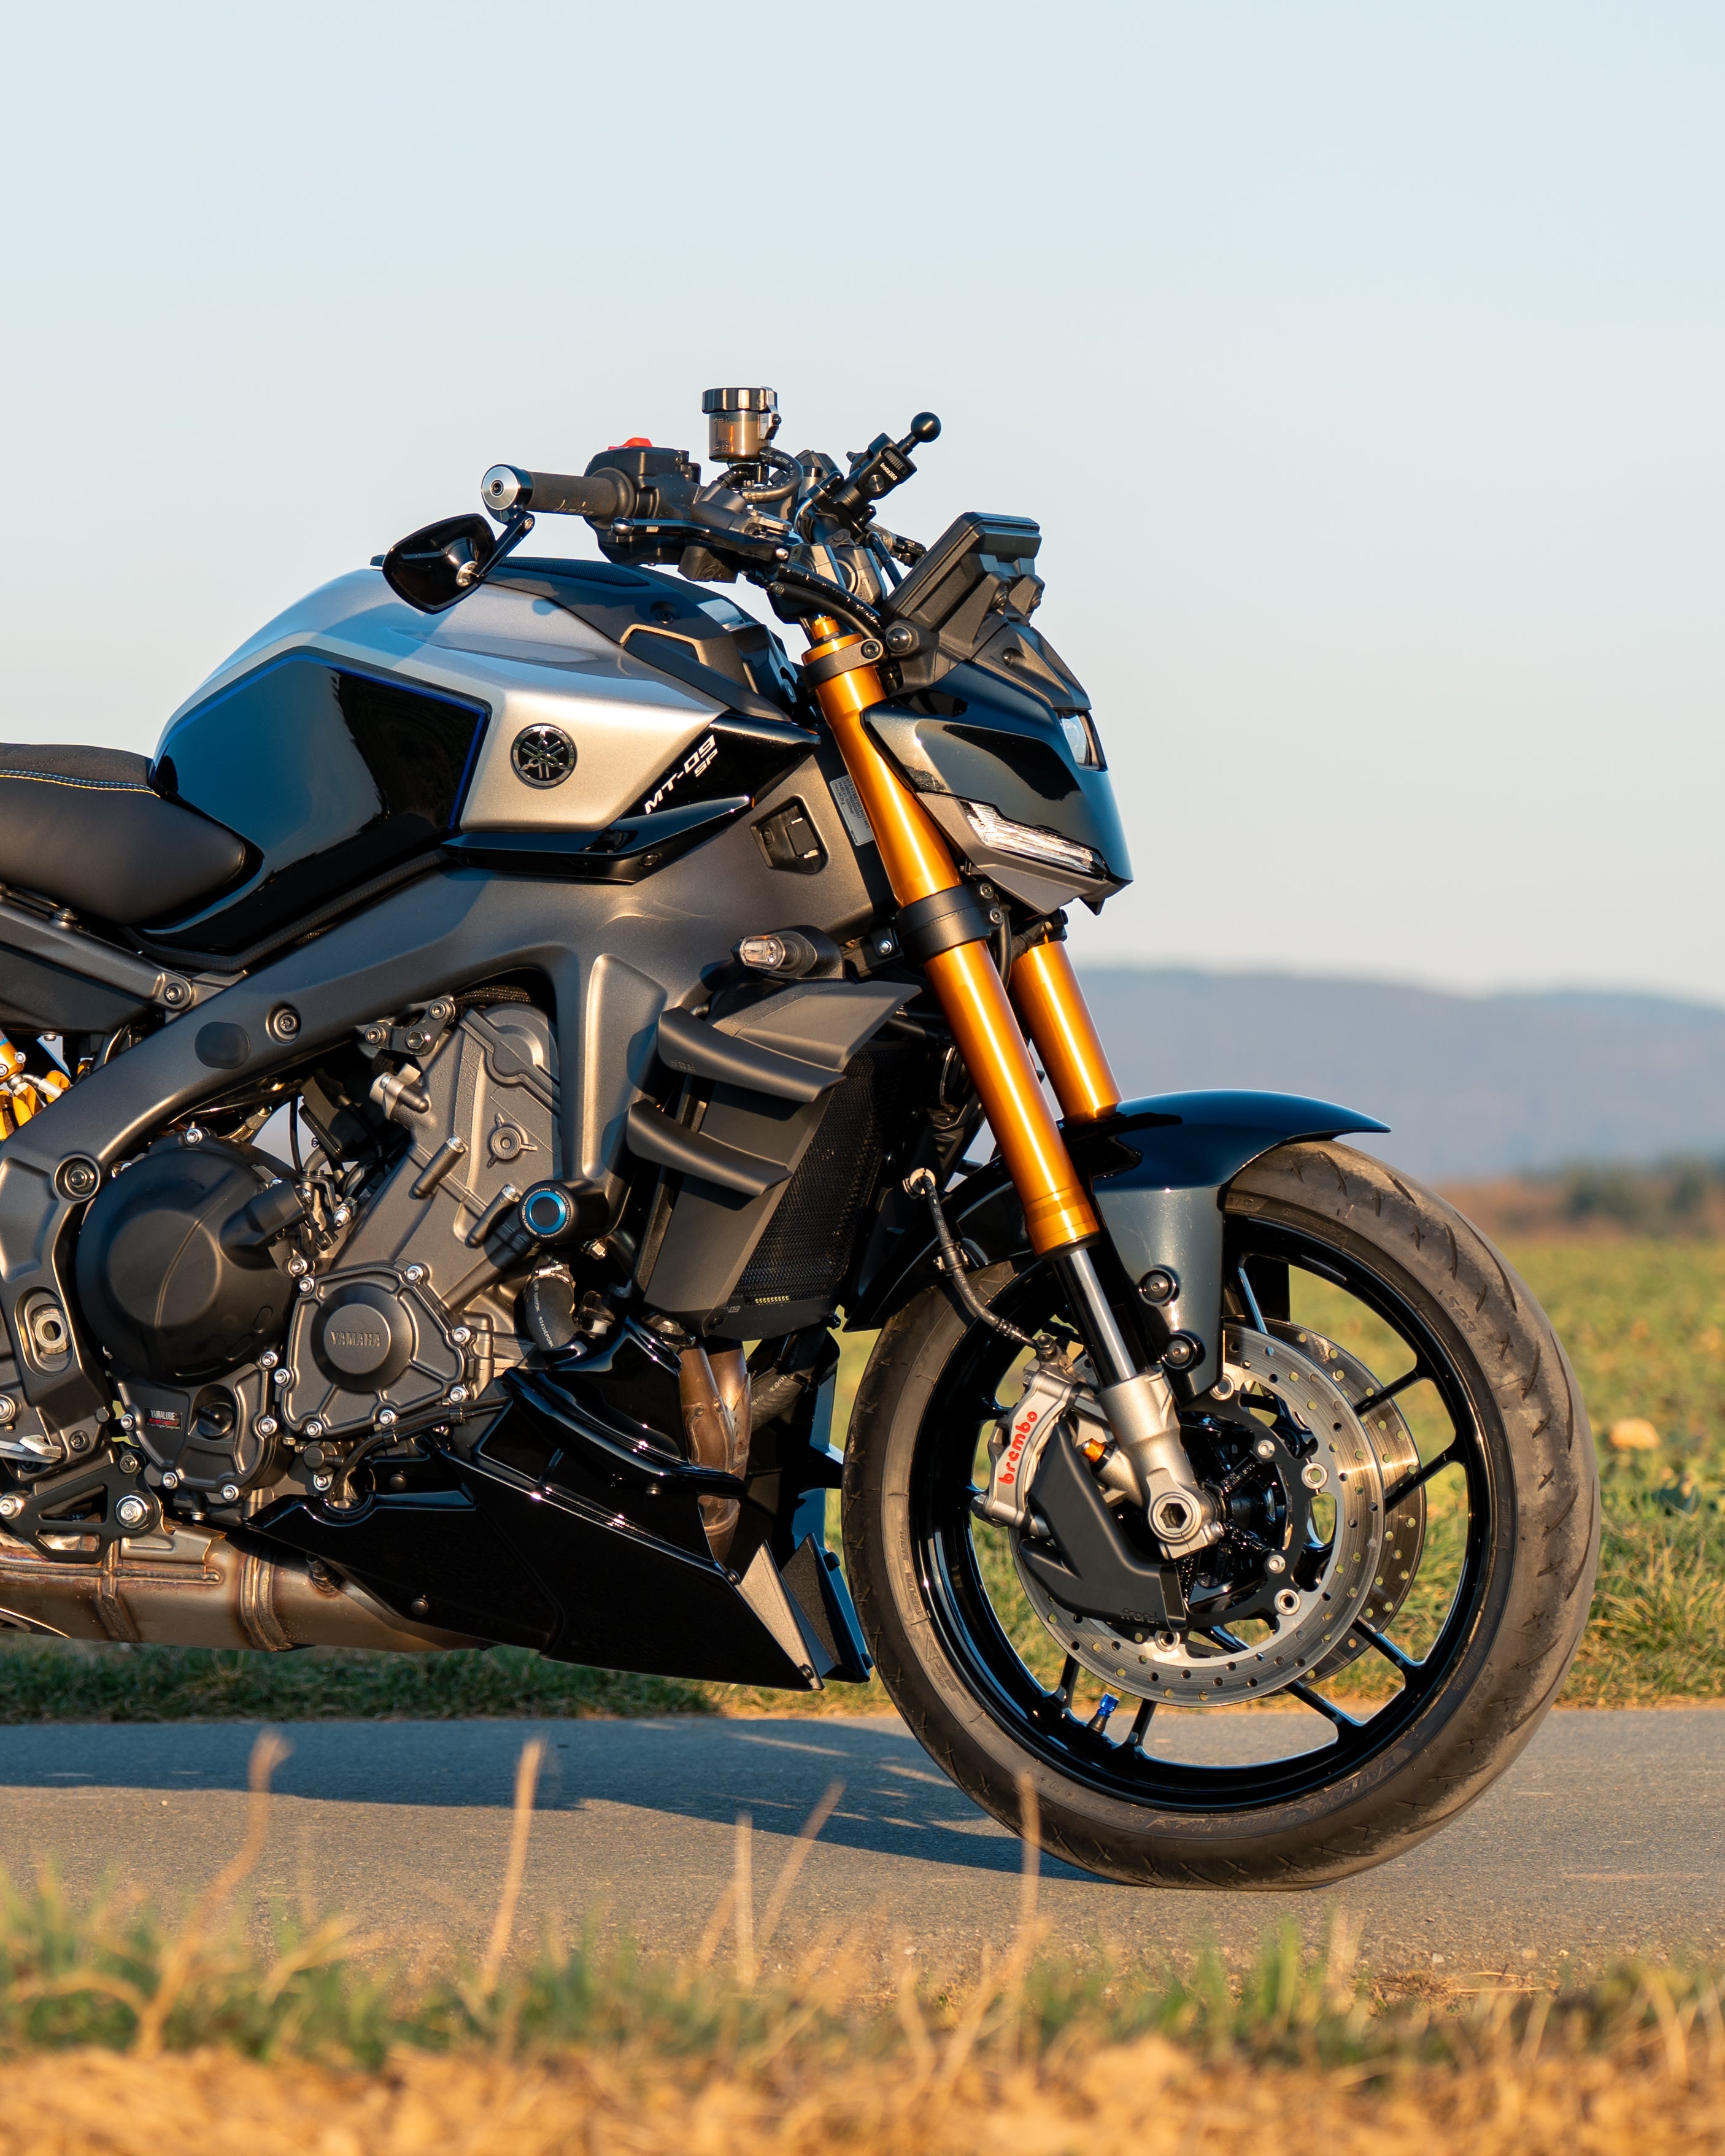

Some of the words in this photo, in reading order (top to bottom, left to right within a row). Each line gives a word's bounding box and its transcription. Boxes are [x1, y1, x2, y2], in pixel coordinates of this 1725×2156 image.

[879, 462, 898, 480] Insta360
[644, 734, 716, 815] MT-09
[694, 748, 718, 778] SP
[1443, 1295, 1477, 1333] S23
[330, 1330, 382, 1347] YAMAHA
[150, 1409, 176, 1421] YAMALUBE
[998, 1411, 1038, 1485] brembo
